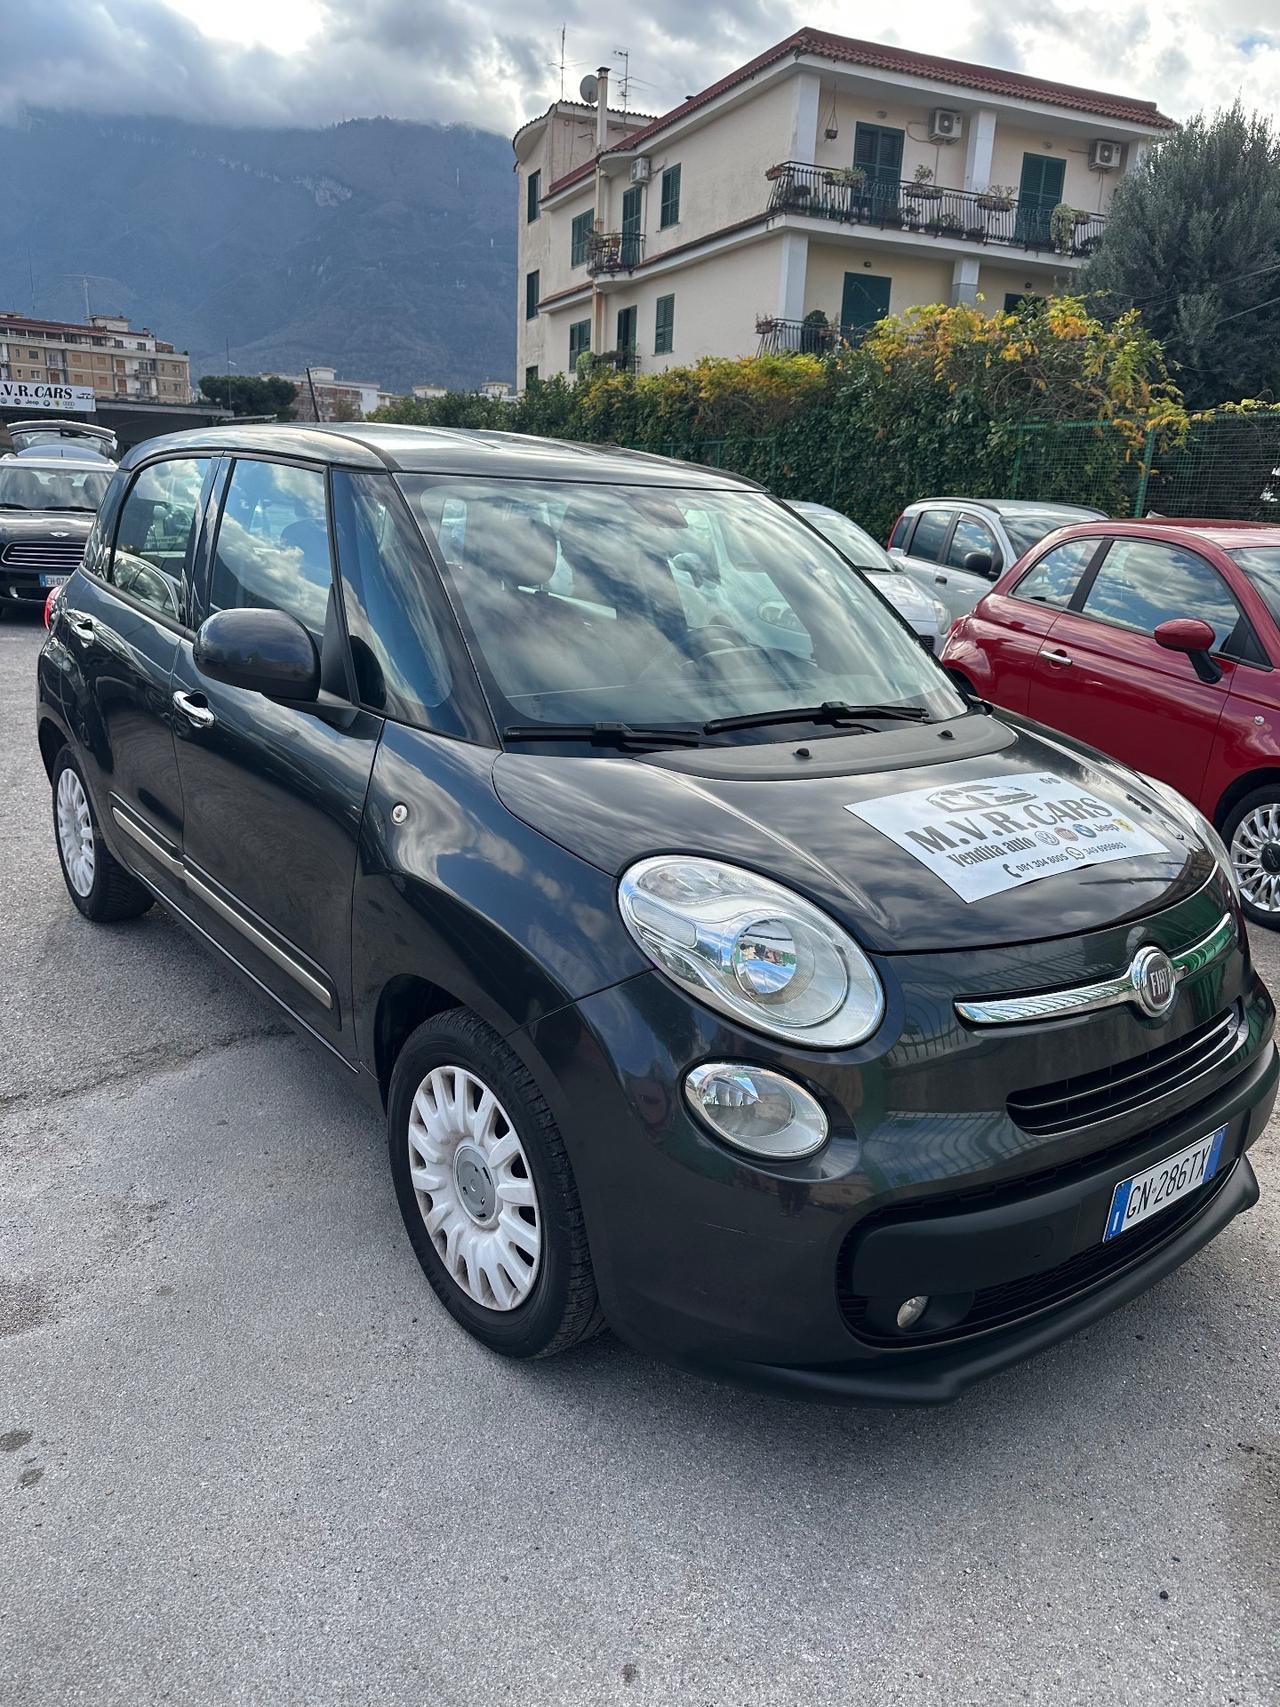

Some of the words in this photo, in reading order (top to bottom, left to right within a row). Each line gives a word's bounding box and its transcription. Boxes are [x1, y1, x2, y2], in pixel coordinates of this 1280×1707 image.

[904, 797, 1113, 855] M.V.R.CARS
[1093, 823, 1120, 832] Jeep
[946, 843, 1008, 868] Vendita
[1002, 836, 1037, 853] auto
[1015, 862, 1034, 872] 081
[1031, 858, 1049, 868] 304
[1149, 966, 1171, 997] FIAT
